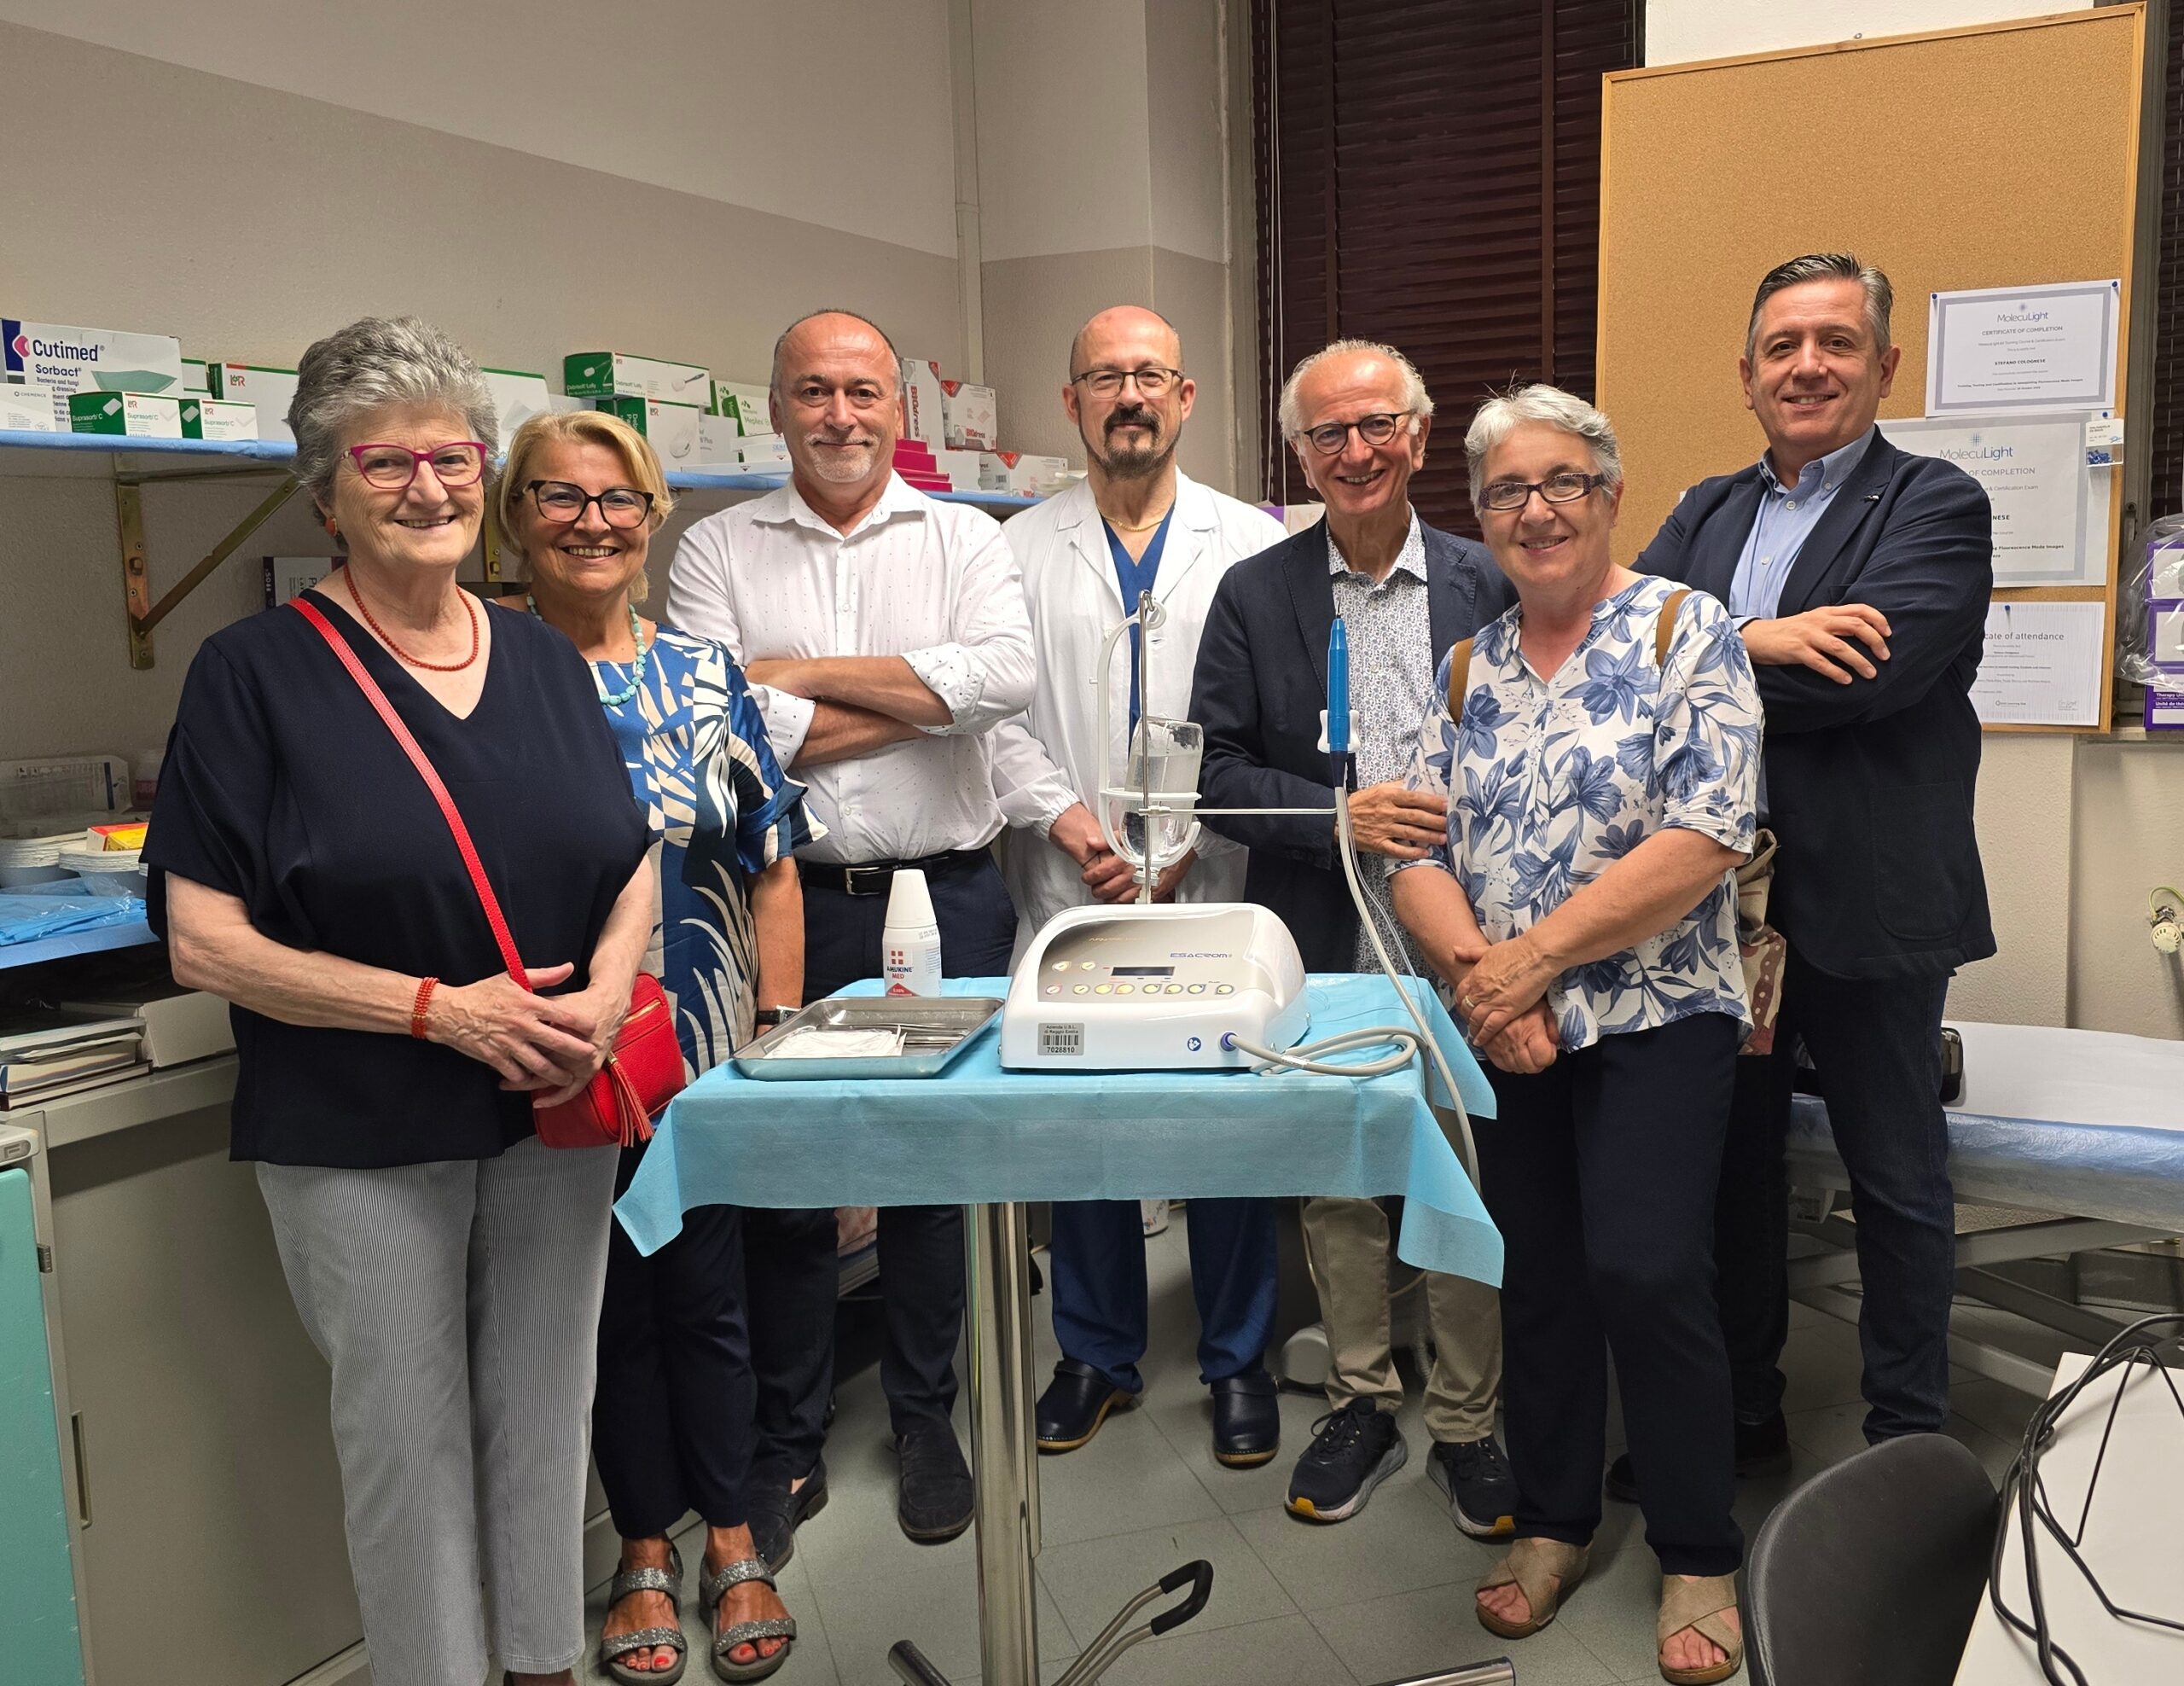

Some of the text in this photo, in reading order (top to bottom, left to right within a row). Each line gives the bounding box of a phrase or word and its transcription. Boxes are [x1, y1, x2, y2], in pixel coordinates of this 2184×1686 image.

[1997, 311, 2048, 323] MolecuLight
[2026, 325, 2063, 334] COMPLETION
[32, 339, 99, 362] Cutimed
[35, 363, 78, 377] Sorbact
[1939, 445, 2013, 461] MolecuLight
[1981, 467, 2036, 476] COMPLETION
[2004, 631, 2013, 640] of
[2015, 631, 2065, 640] attendance
